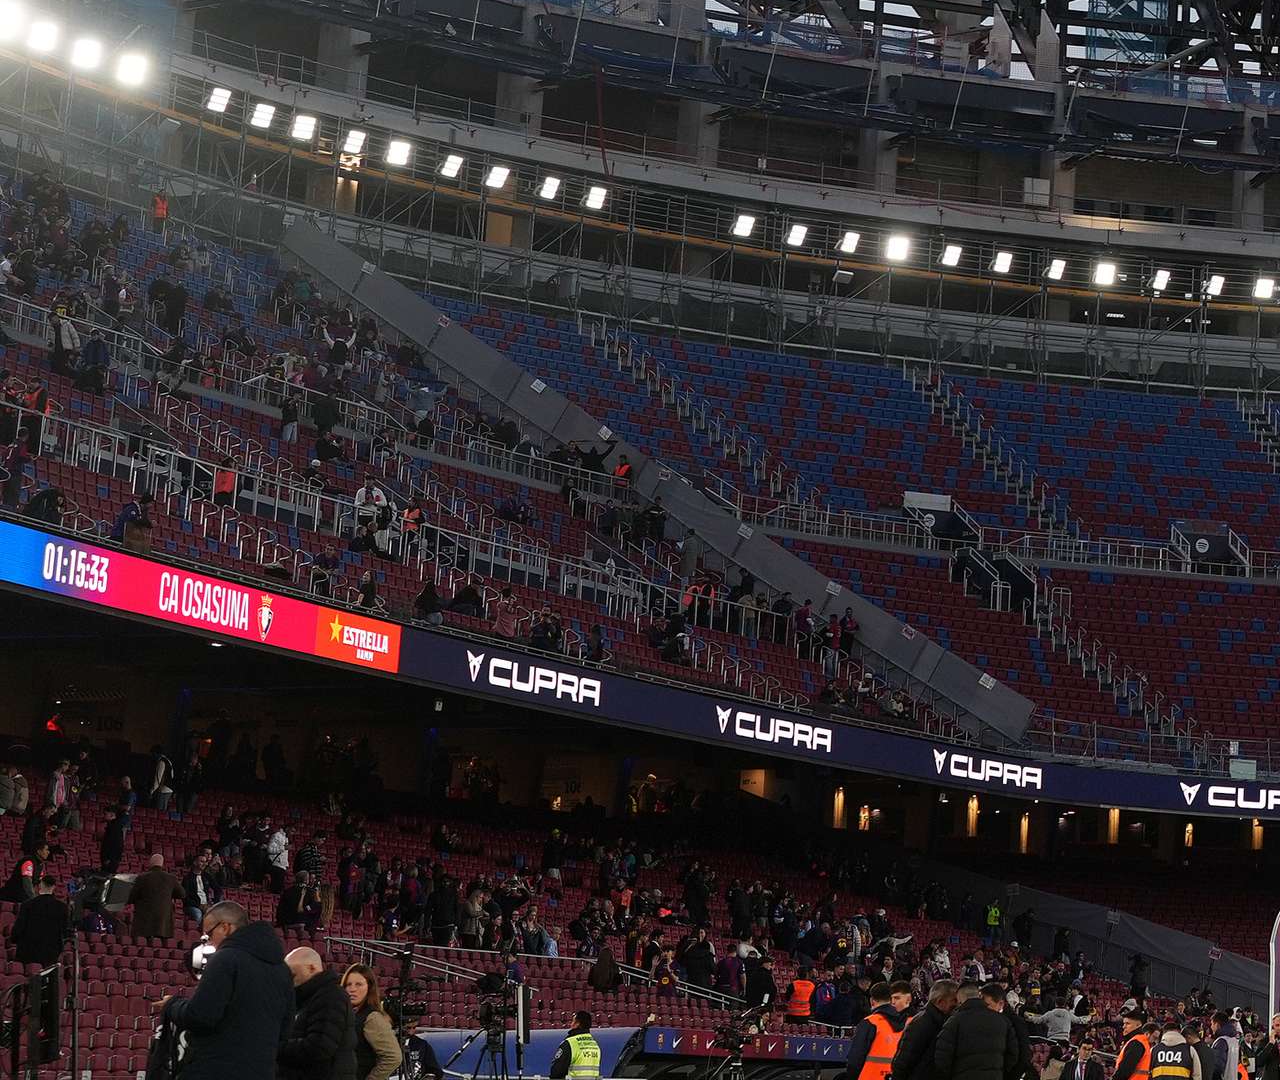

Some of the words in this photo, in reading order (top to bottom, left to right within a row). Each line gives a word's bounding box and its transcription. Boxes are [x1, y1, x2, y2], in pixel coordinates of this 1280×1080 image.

[43, 543, 110, 593] 01:15:33
[158, 571, 179, 614] CA
[181, 577, 250, 631] OSASUNA
[342, 625, 389, 653] ESTRELLA
[488, 657, 602, 707] CUPRA
[735, 711, 833, 753] CUPRA
[949, 753, 1043, 790] CUPRA
[1157, 1050, 1183, 1064] 004
